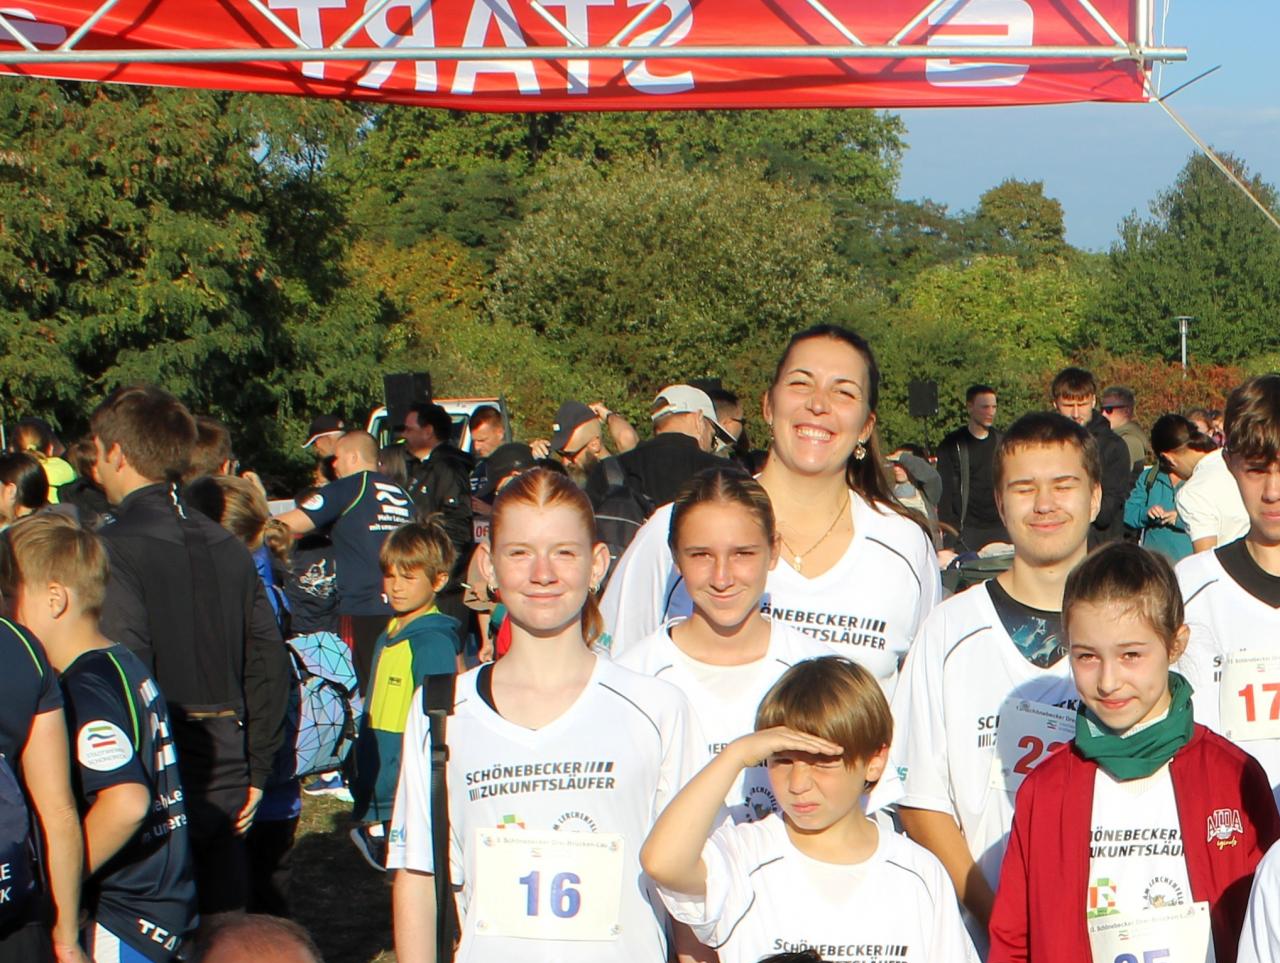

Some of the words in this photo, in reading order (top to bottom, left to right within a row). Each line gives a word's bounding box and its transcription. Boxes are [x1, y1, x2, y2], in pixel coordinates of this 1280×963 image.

[466, 761, 582, 785] SCHÖNEBECKER
[480, 774, 616, 799] ZUKUNFTSLÄUFER
[519, 870, 581, 919] 16
